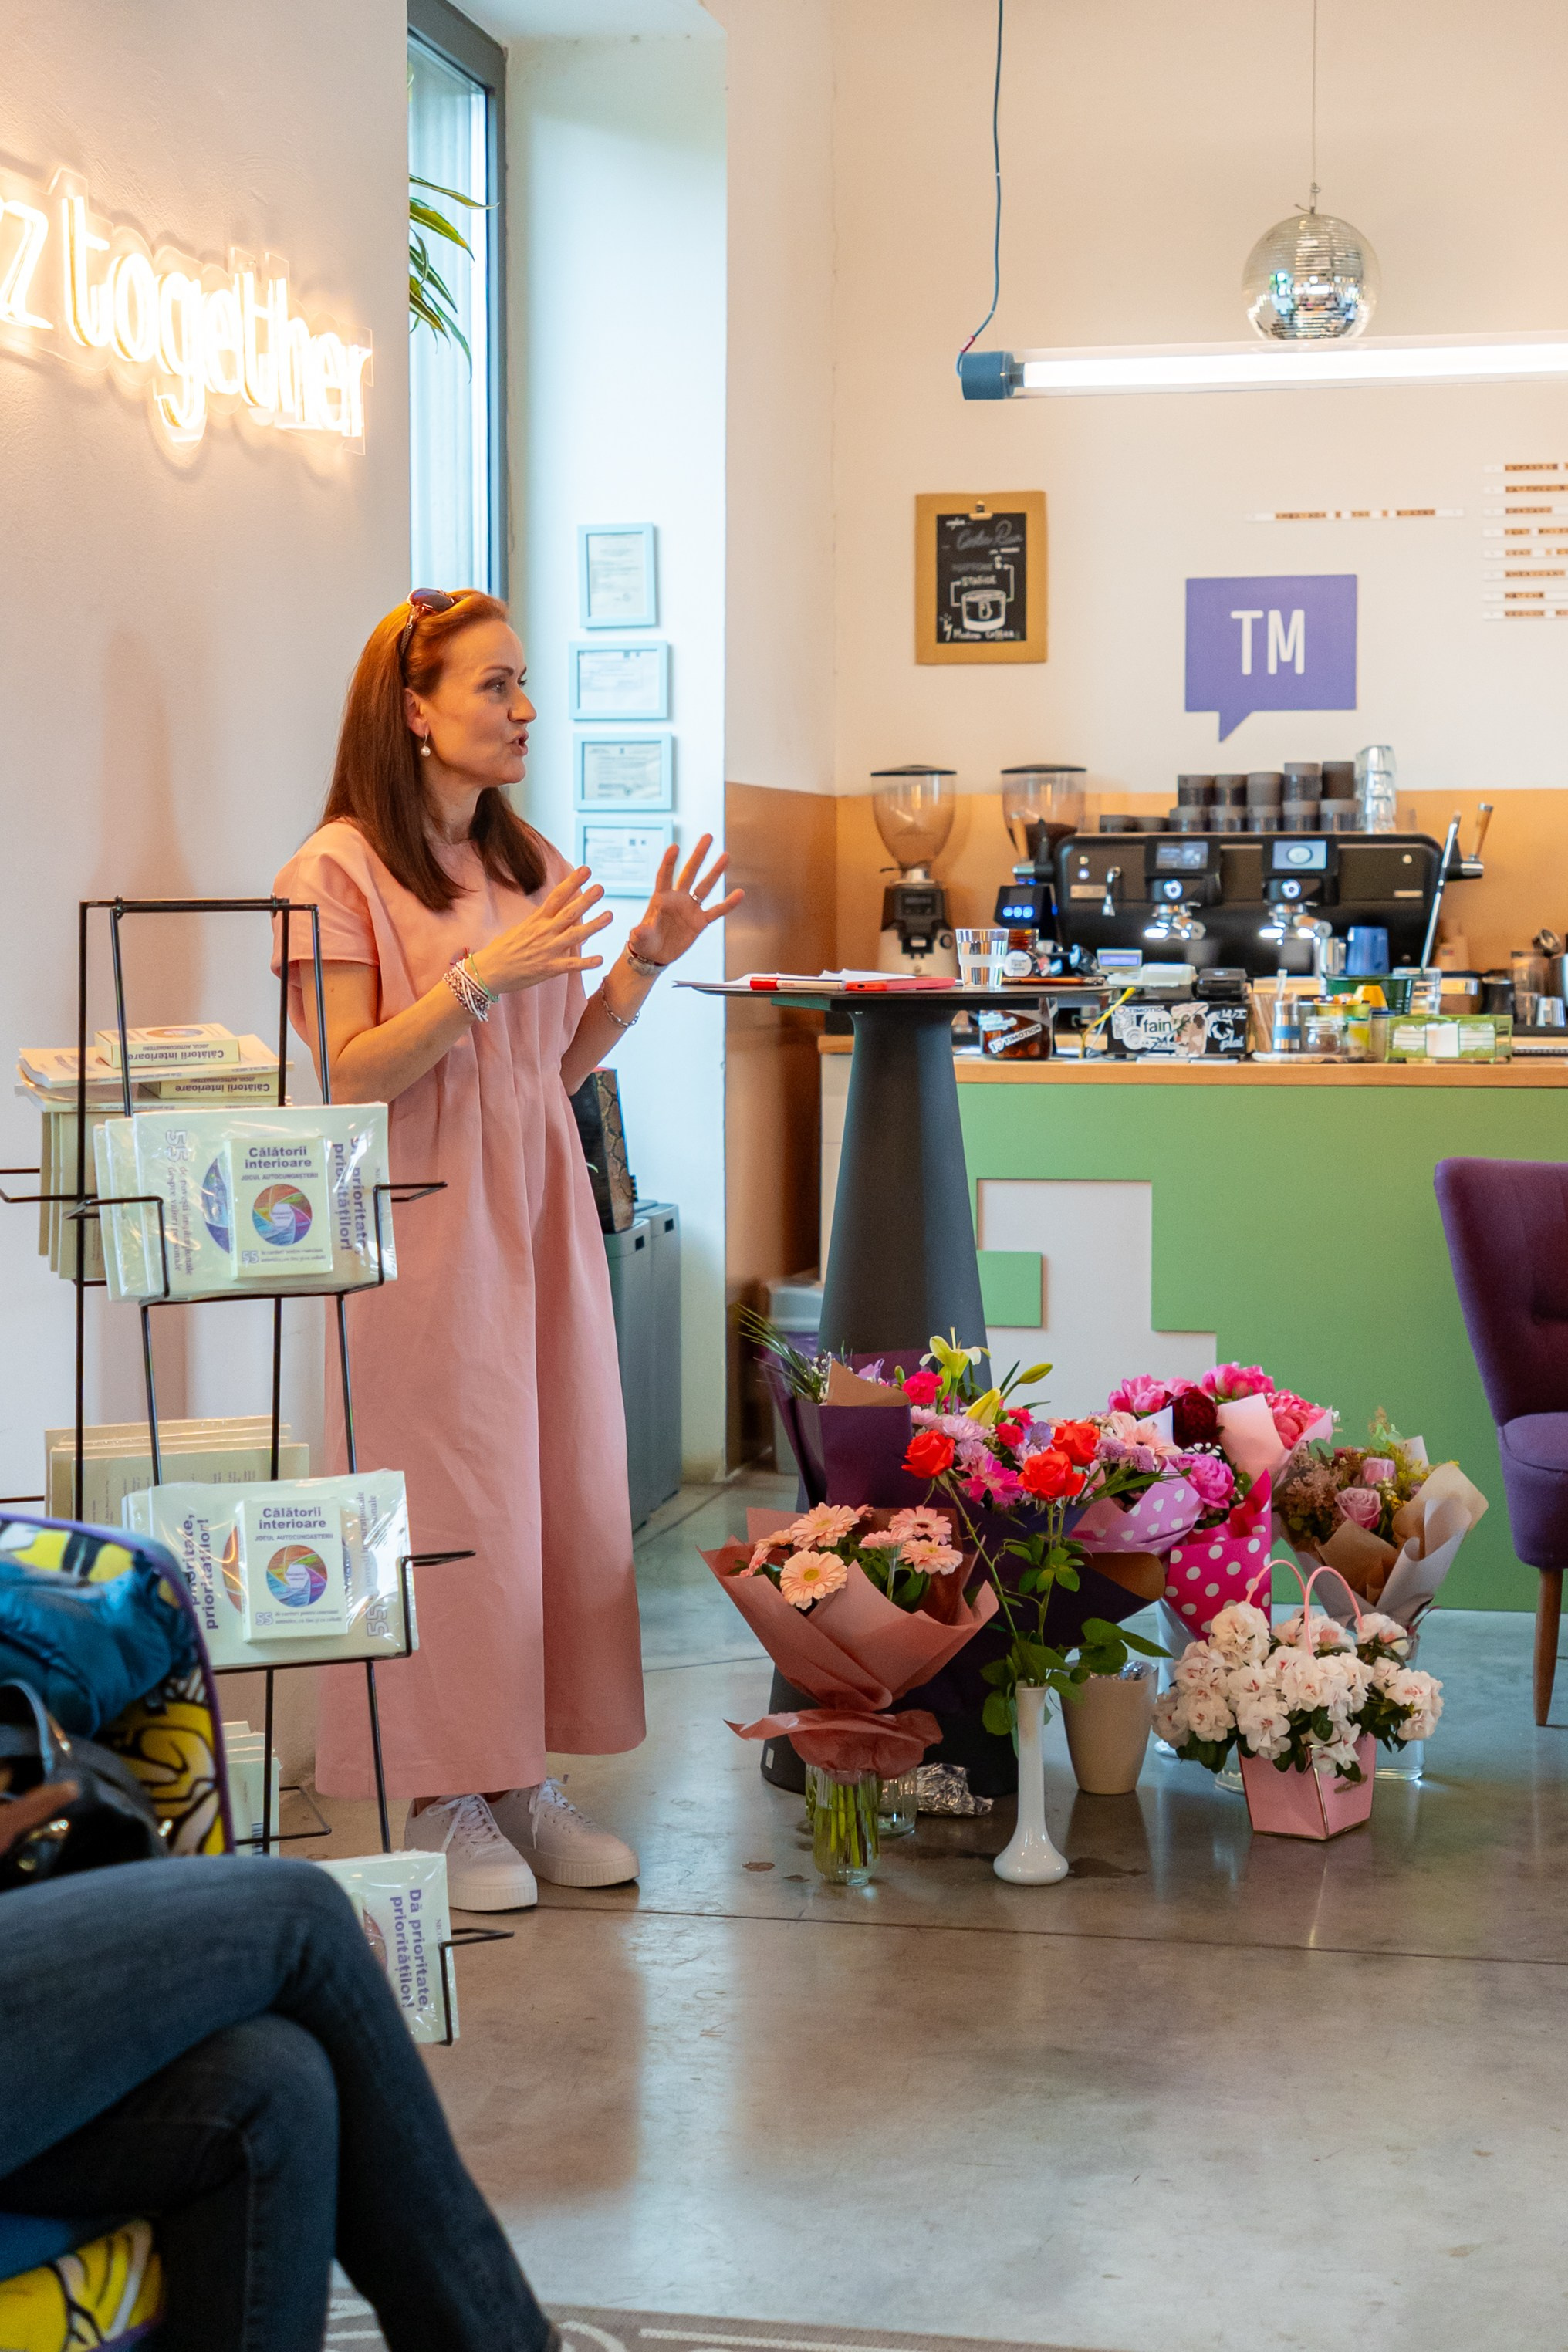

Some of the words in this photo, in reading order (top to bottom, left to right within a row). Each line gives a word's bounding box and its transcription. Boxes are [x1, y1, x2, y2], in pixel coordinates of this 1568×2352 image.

[61, 195, 373, 438] together
[1231, 609, 1305, 675] TM
[1143, 1017, 1173, 1033] fain
[1004, 1025, 1042, 1044] TIMOTION
[128, 1050, 177, 1060] interioare
[175, 1083, 225, 1093] interioare
[164, 1130, 189, 1163] 55
[248, 1145, 308, 1157] Călătorii
[245, 1157, 312, 1169] interioare
[241, 1250, 260, 1264] 55
[262, 1506, 322, 1518] Călătorii
[259, 1519, 326, 1530] interioare
[255, 1611, 273, 1626] 55
[365, 1603, 389, 1637] 55
[409, 1888, 423, 1913] Dă
[390, 1896, 415, 2008] priorităților!
[408, 1919, 430, 2012] prioritate,
